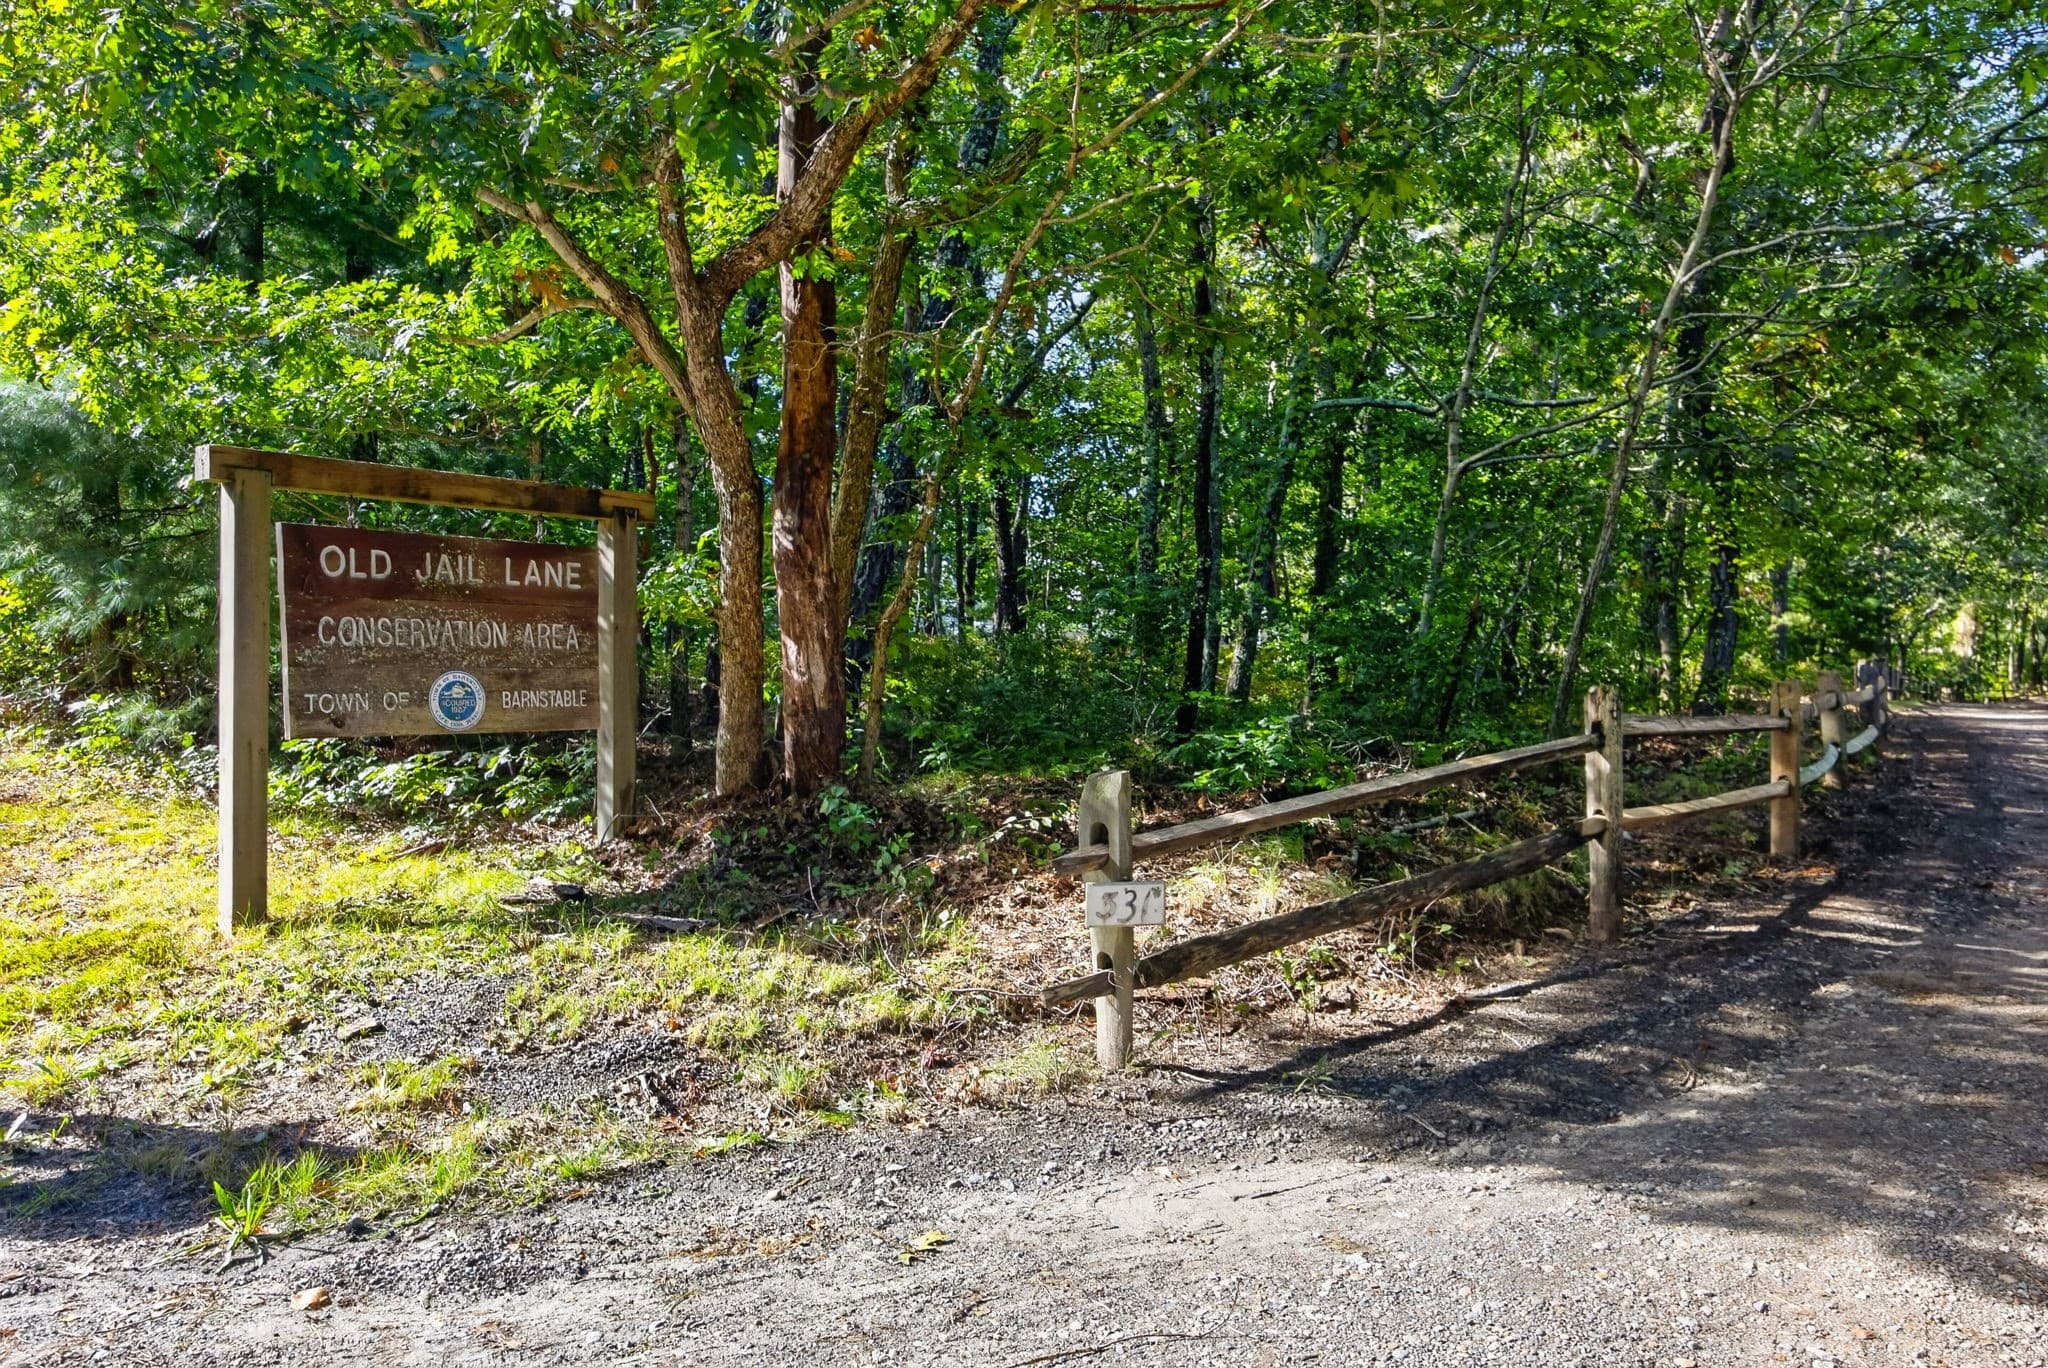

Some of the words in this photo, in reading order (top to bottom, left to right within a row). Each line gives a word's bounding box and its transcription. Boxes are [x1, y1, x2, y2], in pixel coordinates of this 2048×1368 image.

[319, 545, 392, 579] OLD
[415, 551, 484, 585] JAIL
[504, 557, 582, 590] LANE
[318, 615, 509, 649] CONSERVATION
[523, 622, 580, 651] AREA
[304, 692, 370, 714] TOWN
[383, 691, 410, 711] OF
[502, 688, 588, 709] BARNSTABLE
